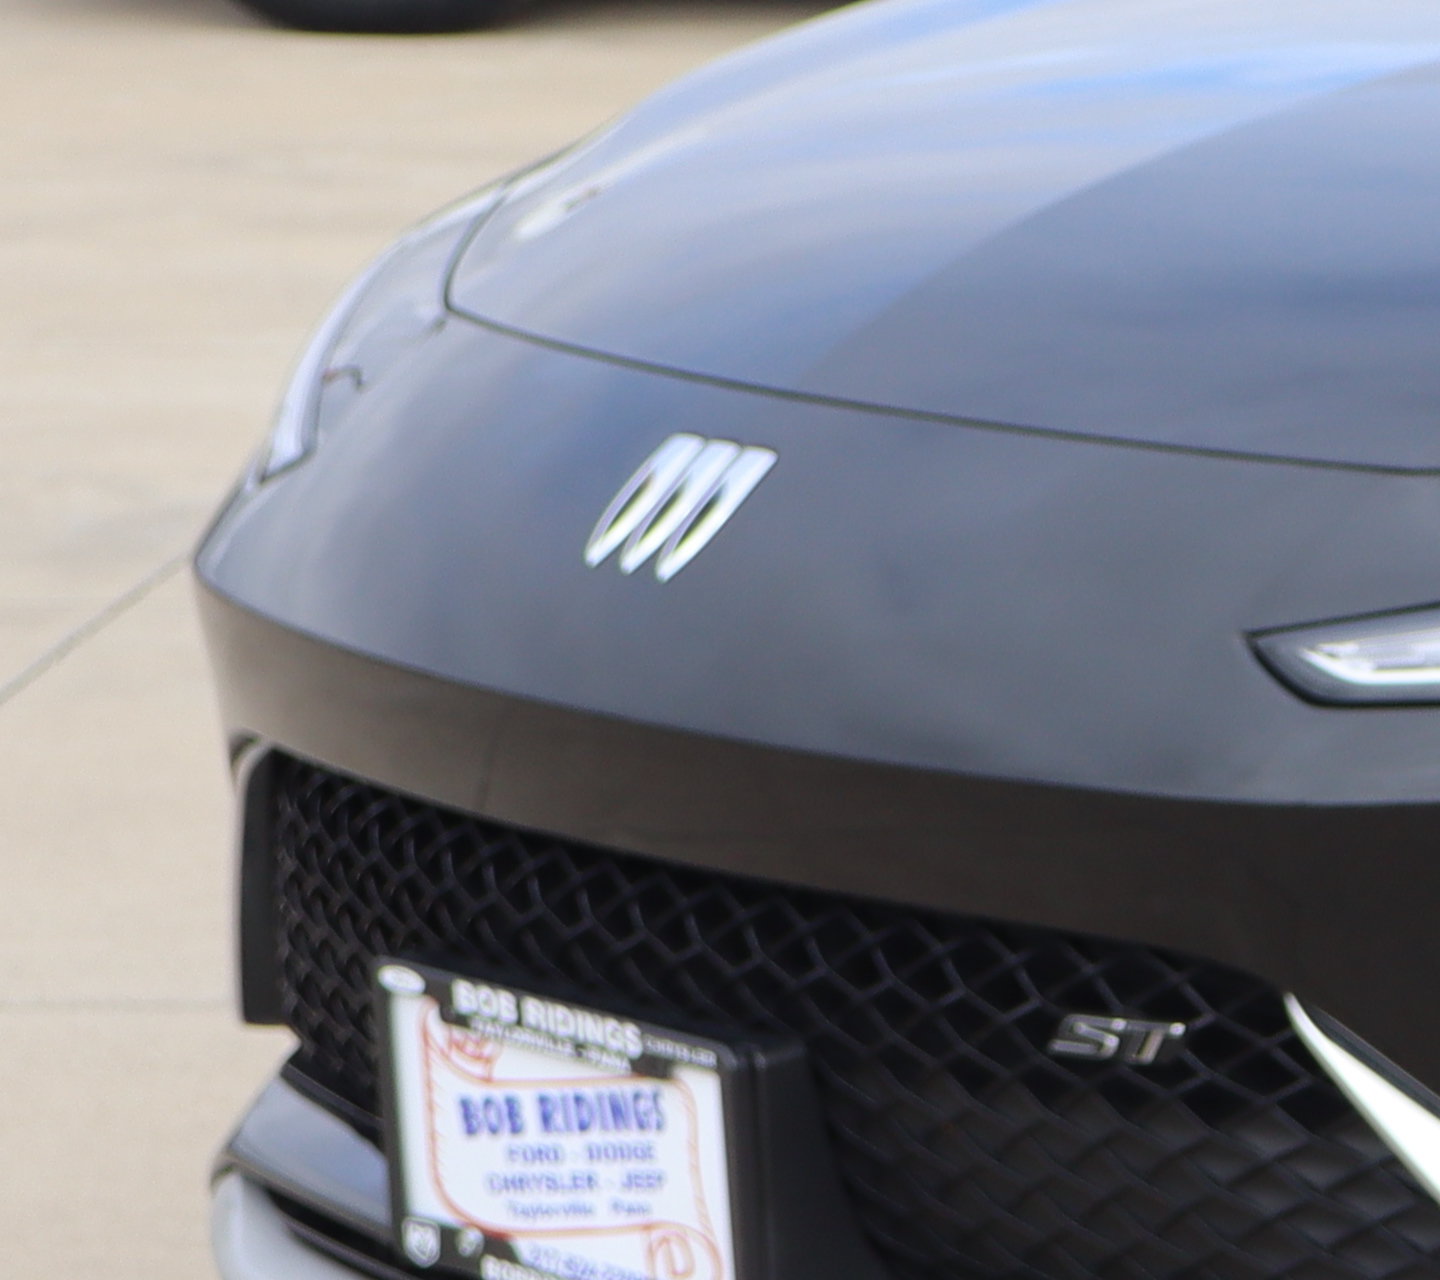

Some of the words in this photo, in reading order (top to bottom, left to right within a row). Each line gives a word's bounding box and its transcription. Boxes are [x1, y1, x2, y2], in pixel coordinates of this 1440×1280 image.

[452, 978, 518, 1025] BOB
[519, 996, 643, 1060] RIDINGS
[1050, 1014, 1186, 1064] ST
[460, 1095, 524, 1136] BOB
[537, 1088, 665, 1134] RIDINGS
